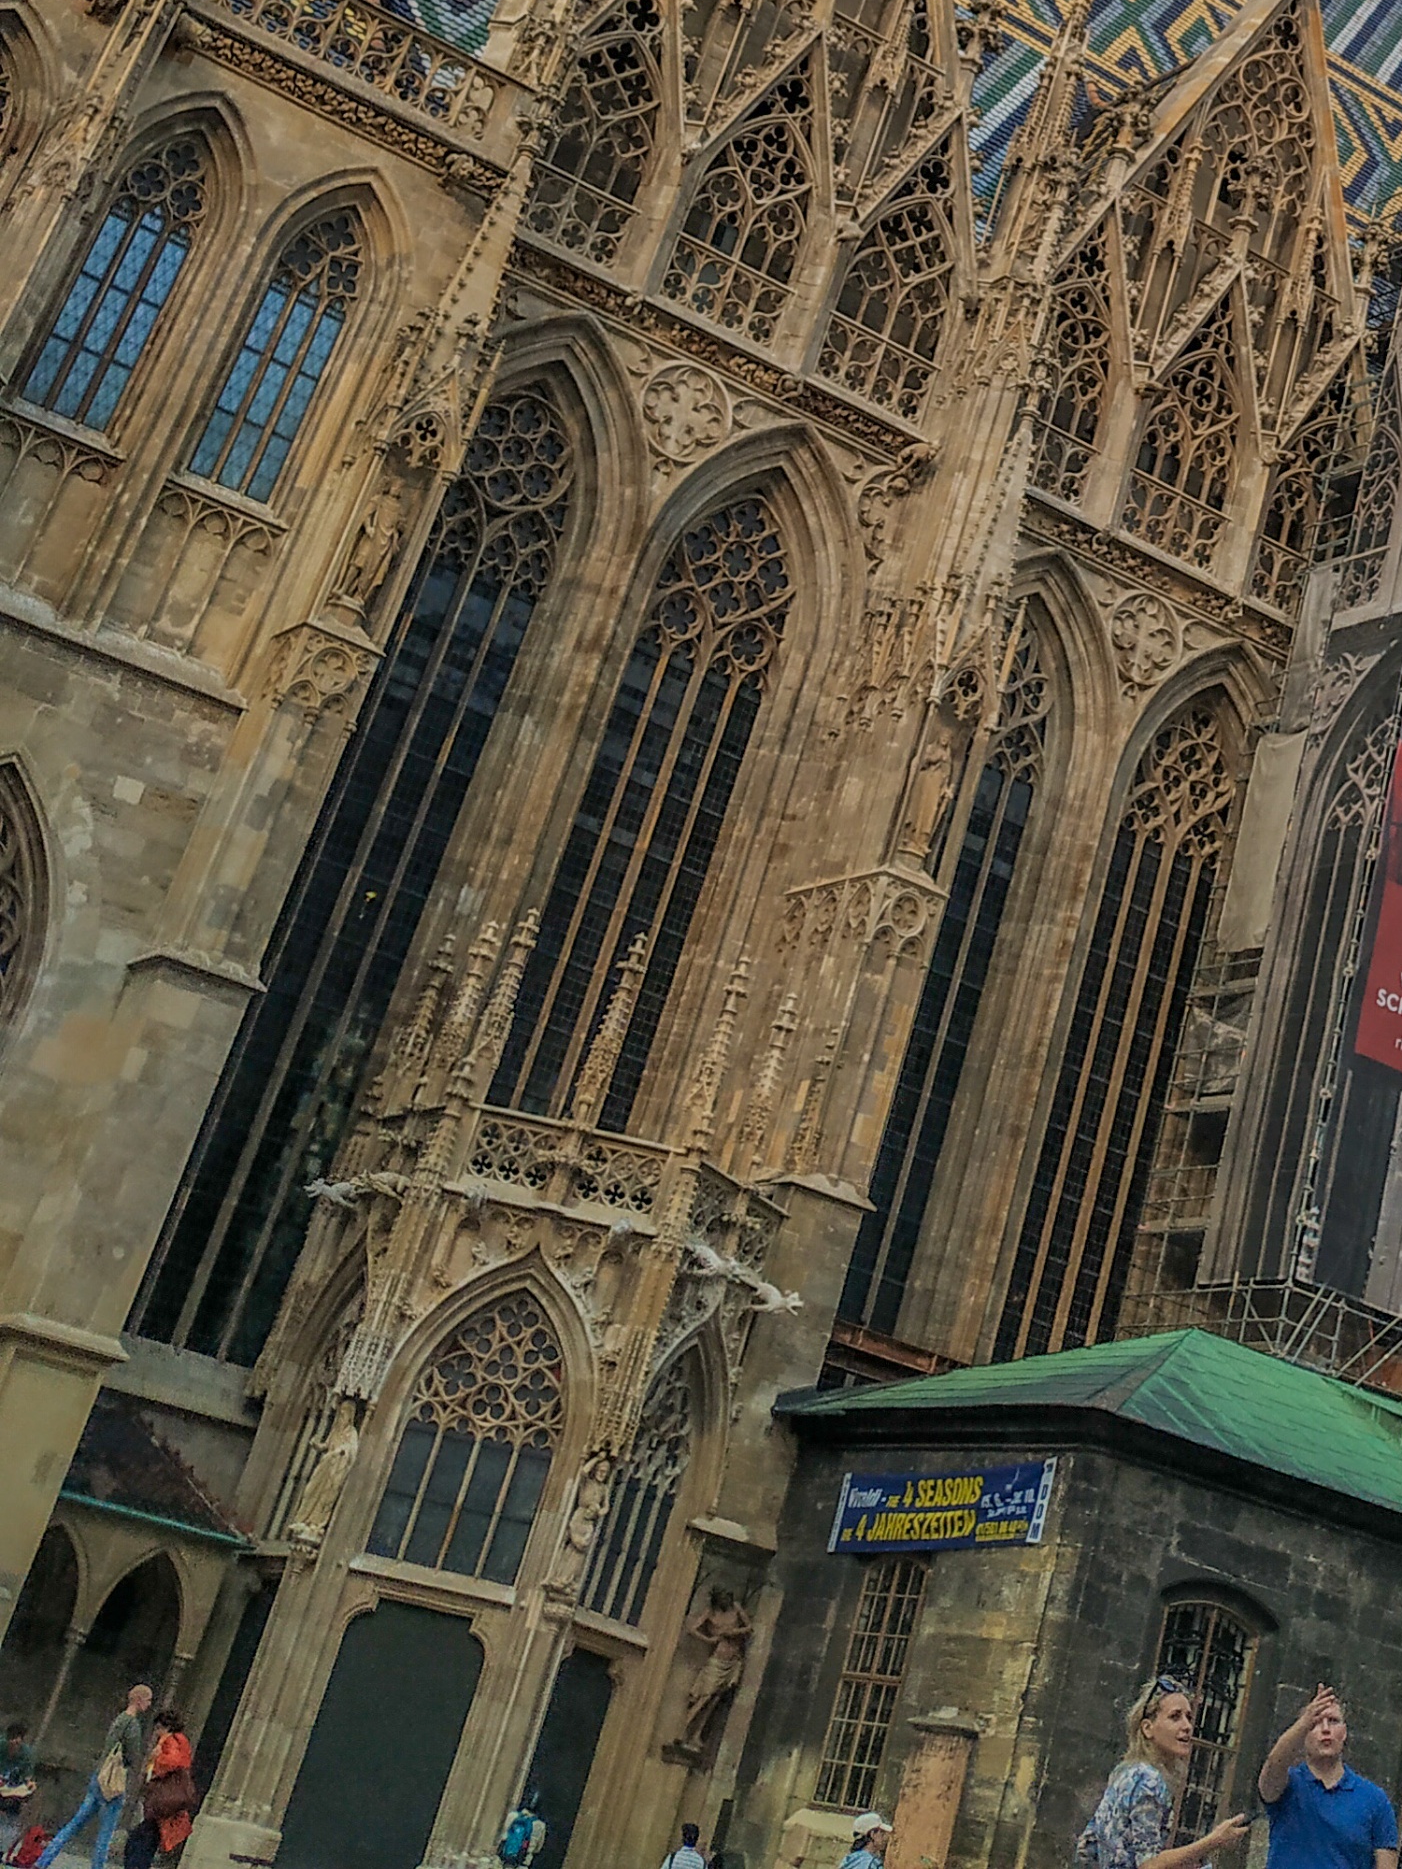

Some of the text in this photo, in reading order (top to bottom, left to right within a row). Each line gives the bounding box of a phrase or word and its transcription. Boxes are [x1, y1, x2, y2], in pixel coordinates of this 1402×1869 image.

[902, 1480, 914, 1508] 4
[915, 1476, 984, 1508] SEASONS
[855, 1514, 868, 1542] 4
[866, 1509, 977, 1542] JAHRESZEITEN
